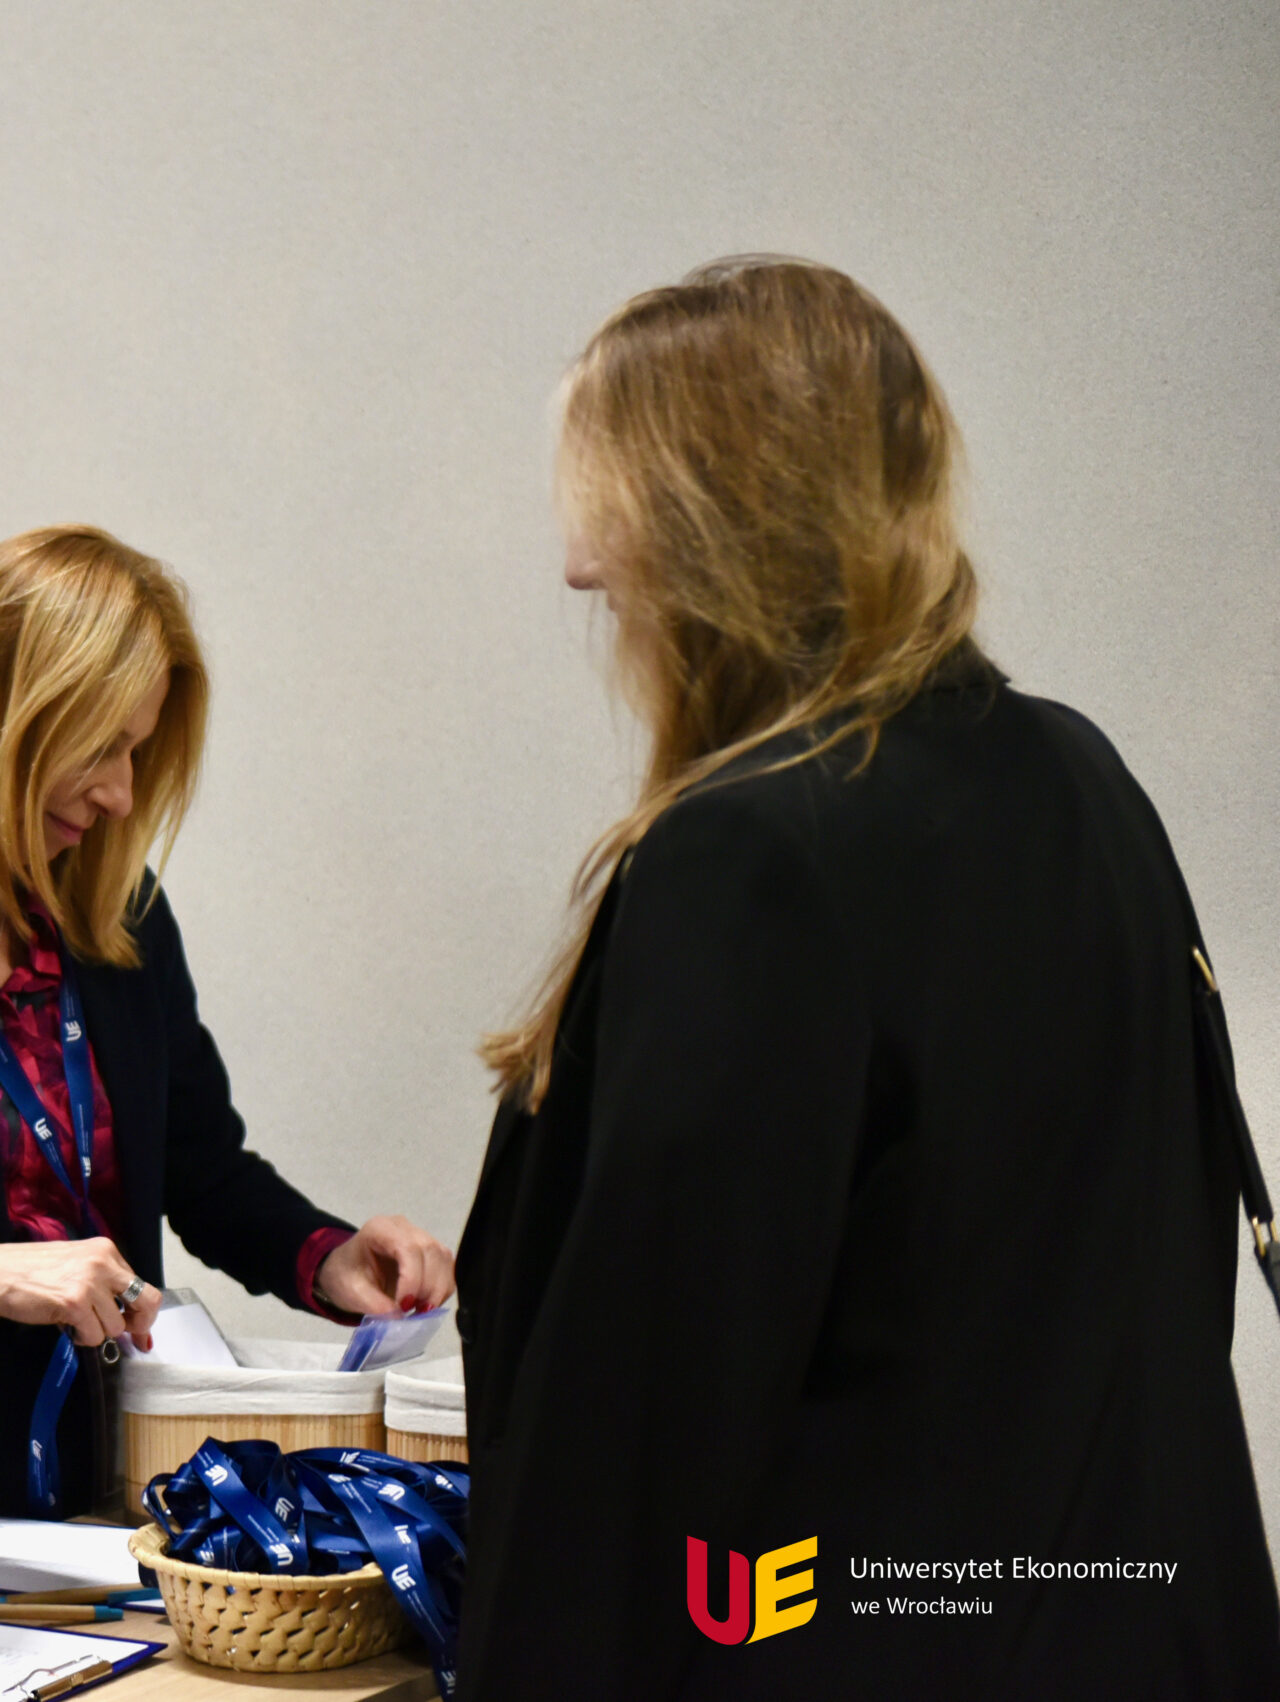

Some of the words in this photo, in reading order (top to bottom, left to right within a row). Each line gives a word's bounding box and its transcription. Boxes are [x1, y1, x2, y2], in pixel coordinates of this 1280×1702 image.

[65, 1020, 82, 1042] UE
[34, 1117, 53, 1141] UE
[205, 1464, 228, 1487] UE
[269, 1543, 294, 1567] UE
[391, 1563, 416, 1591] UE
